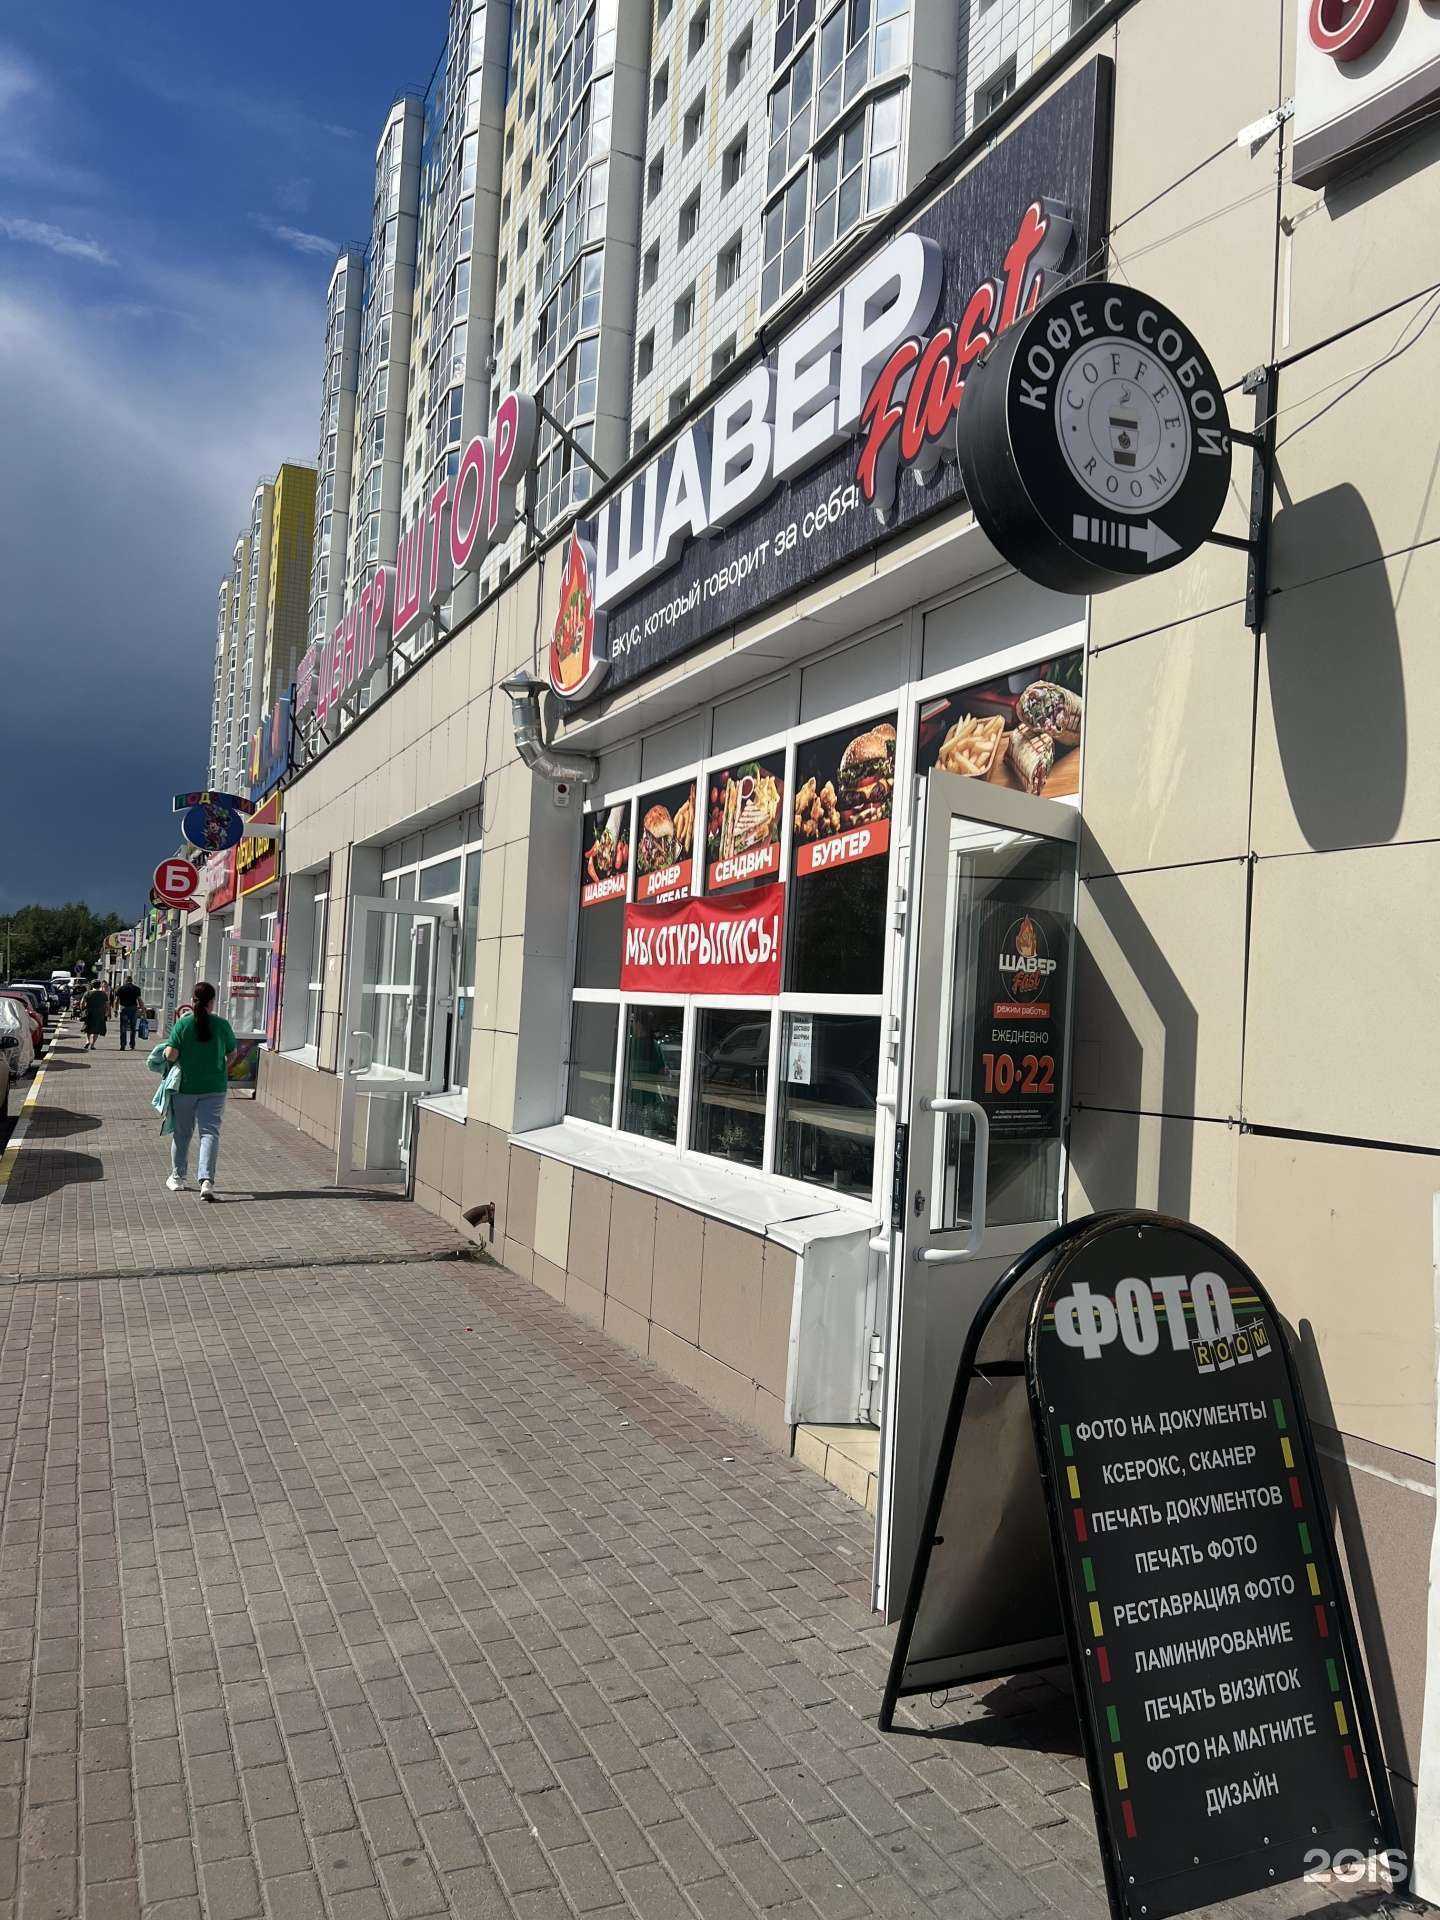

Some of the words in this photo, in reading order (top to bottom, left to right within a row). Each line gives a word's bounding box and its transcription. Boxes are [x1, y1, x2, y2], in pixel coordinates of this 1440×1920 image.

[1019, 301, 1095, 411] КОФЕ
[1104, 298, 1125, 332] С
[1136, 310, 1230, 457] СОБОЙ
[1066, 353, 1182, 430] COFFEE
[595, 232, 932, 610] ШАВЕР
[1083, 456, 1168, 498] ROOM
[315, 565, 386, 729] ЦЕНТР
[392, 390, 520, 642] ШТОР
[612, 624, 642, 659] вкус,
[644, 582, 701, 637] который
[703, 539, 770, 601] говорит
[774, 522, 798, 557] за
[715, 847, 773, 882] СЕНДВИЧ
[812, 829, 871, 868] БУРГЕР
[165, 866, 190, 892] Б
[585, 874, 626, 901] ШАВЕРМА
[647, 865, 681, 896] ДОНЕР
[625, 927, 656, 966] МЫ
[655, 915, 779, 966] ОТКРЫЛИСЬ!
[999, 953, 1057, 975] ШАВЕР
[996, 1005, 1021, 1015] режим
[1021, 1005, 1047, 1016] работы
[992, 1029, 1049, 1044] ЕЖЕДНЕВНО
[1054, 1271, 1237, 1360] ФОТО
[1197, 1327, 1268, 1368] ROOM
[1076, 1417, 1127, 1441] ФОТО
[1131, 1414, 1156, 1433] НА
[1159, 1400, 1267, 1435] ДОКУМЕНТЫ
[1102, 1454, 1186, 1484] КСЕРОКС,
[1189, 1445, 1257, 1471] СКАНЕР
[1091, 1503, 1162, 1533] ПЕЧАТЬ
[1165, 1485, 1283, 1525] ДОКУМЕНТОВ
[1135, 1542, 1203, 1574] ПЕЧАТЬ
[1207, 1534, 1258, 1561] ФОТО
[1113, 1583, 1240, 1627] РЕСТАВРАЦИЯ
[1244, 1574, 1295, 1601] ФОТО
[1135, 1621, 1294, 1674] ЛАМИНИРОВАНИЕ
[1144, 1687, 1217, 1722] ПЕЧАТЬ
[1219, 1667, 1302, 1705] ВИЗИТОК
[1146, 1740, 1201, 1774] ФОТО
[1204, 1734, 1230, 1760] НА
[1232, 1713, 1317, 1754] МАГНИТЕ
[1205, 1771, 1280, 1816] ДИЗАЙН
